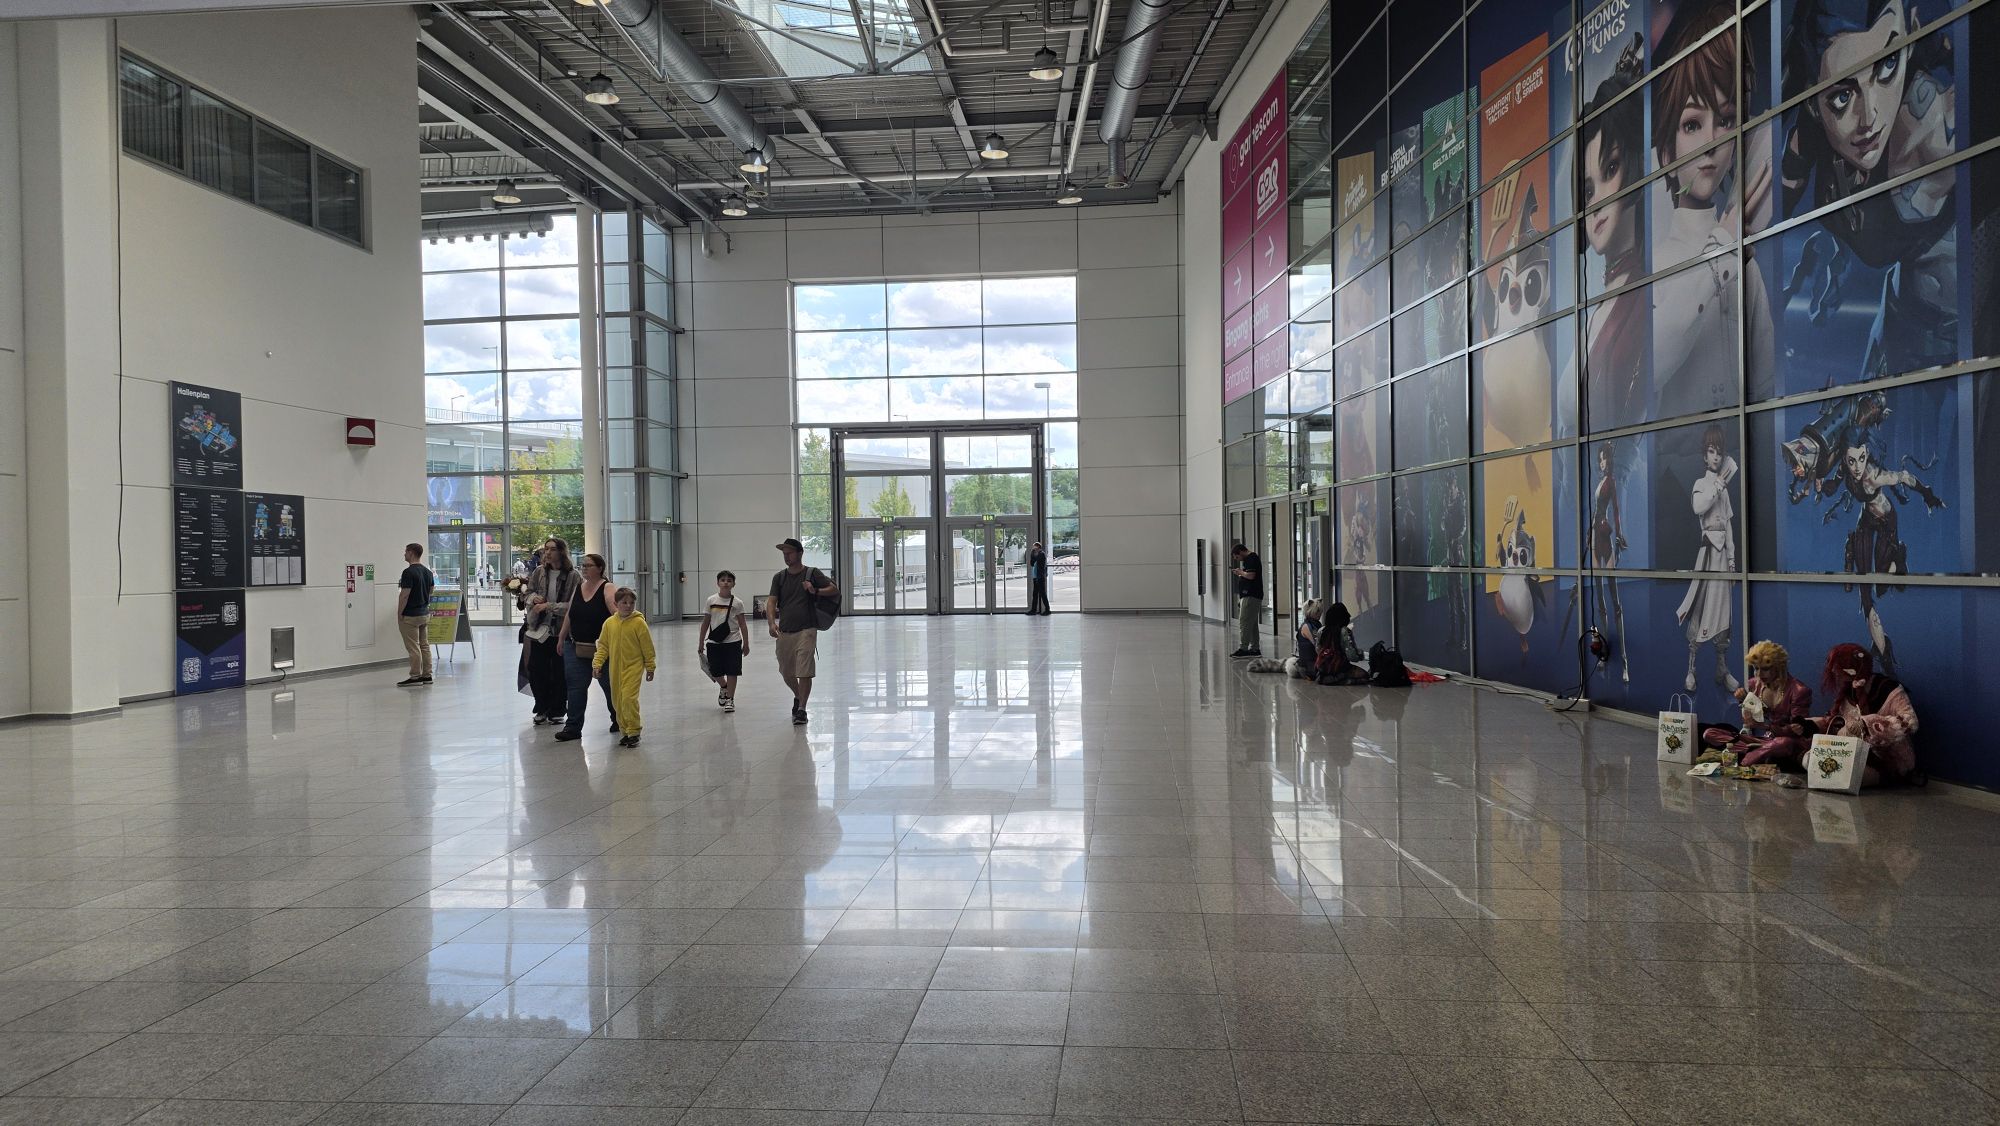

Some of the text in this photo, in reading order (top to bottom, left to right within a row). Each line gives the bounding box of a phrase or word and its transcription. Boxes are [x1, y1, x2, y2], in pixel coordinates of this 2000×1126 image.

[1592, 13, 1626, 54] KINGS
[1522, 65, 1544, 88] GOLDEN
[1522, 77, 1544, 98] SPATULA
[1485, 91, 1512, 120] TEAMFIGHT
[1488, 104, 1509, 126] TACTICS
[1433, 138, 1466, 171] DELTA FORCE
[177, 386, 210, 400] Hallenplan
